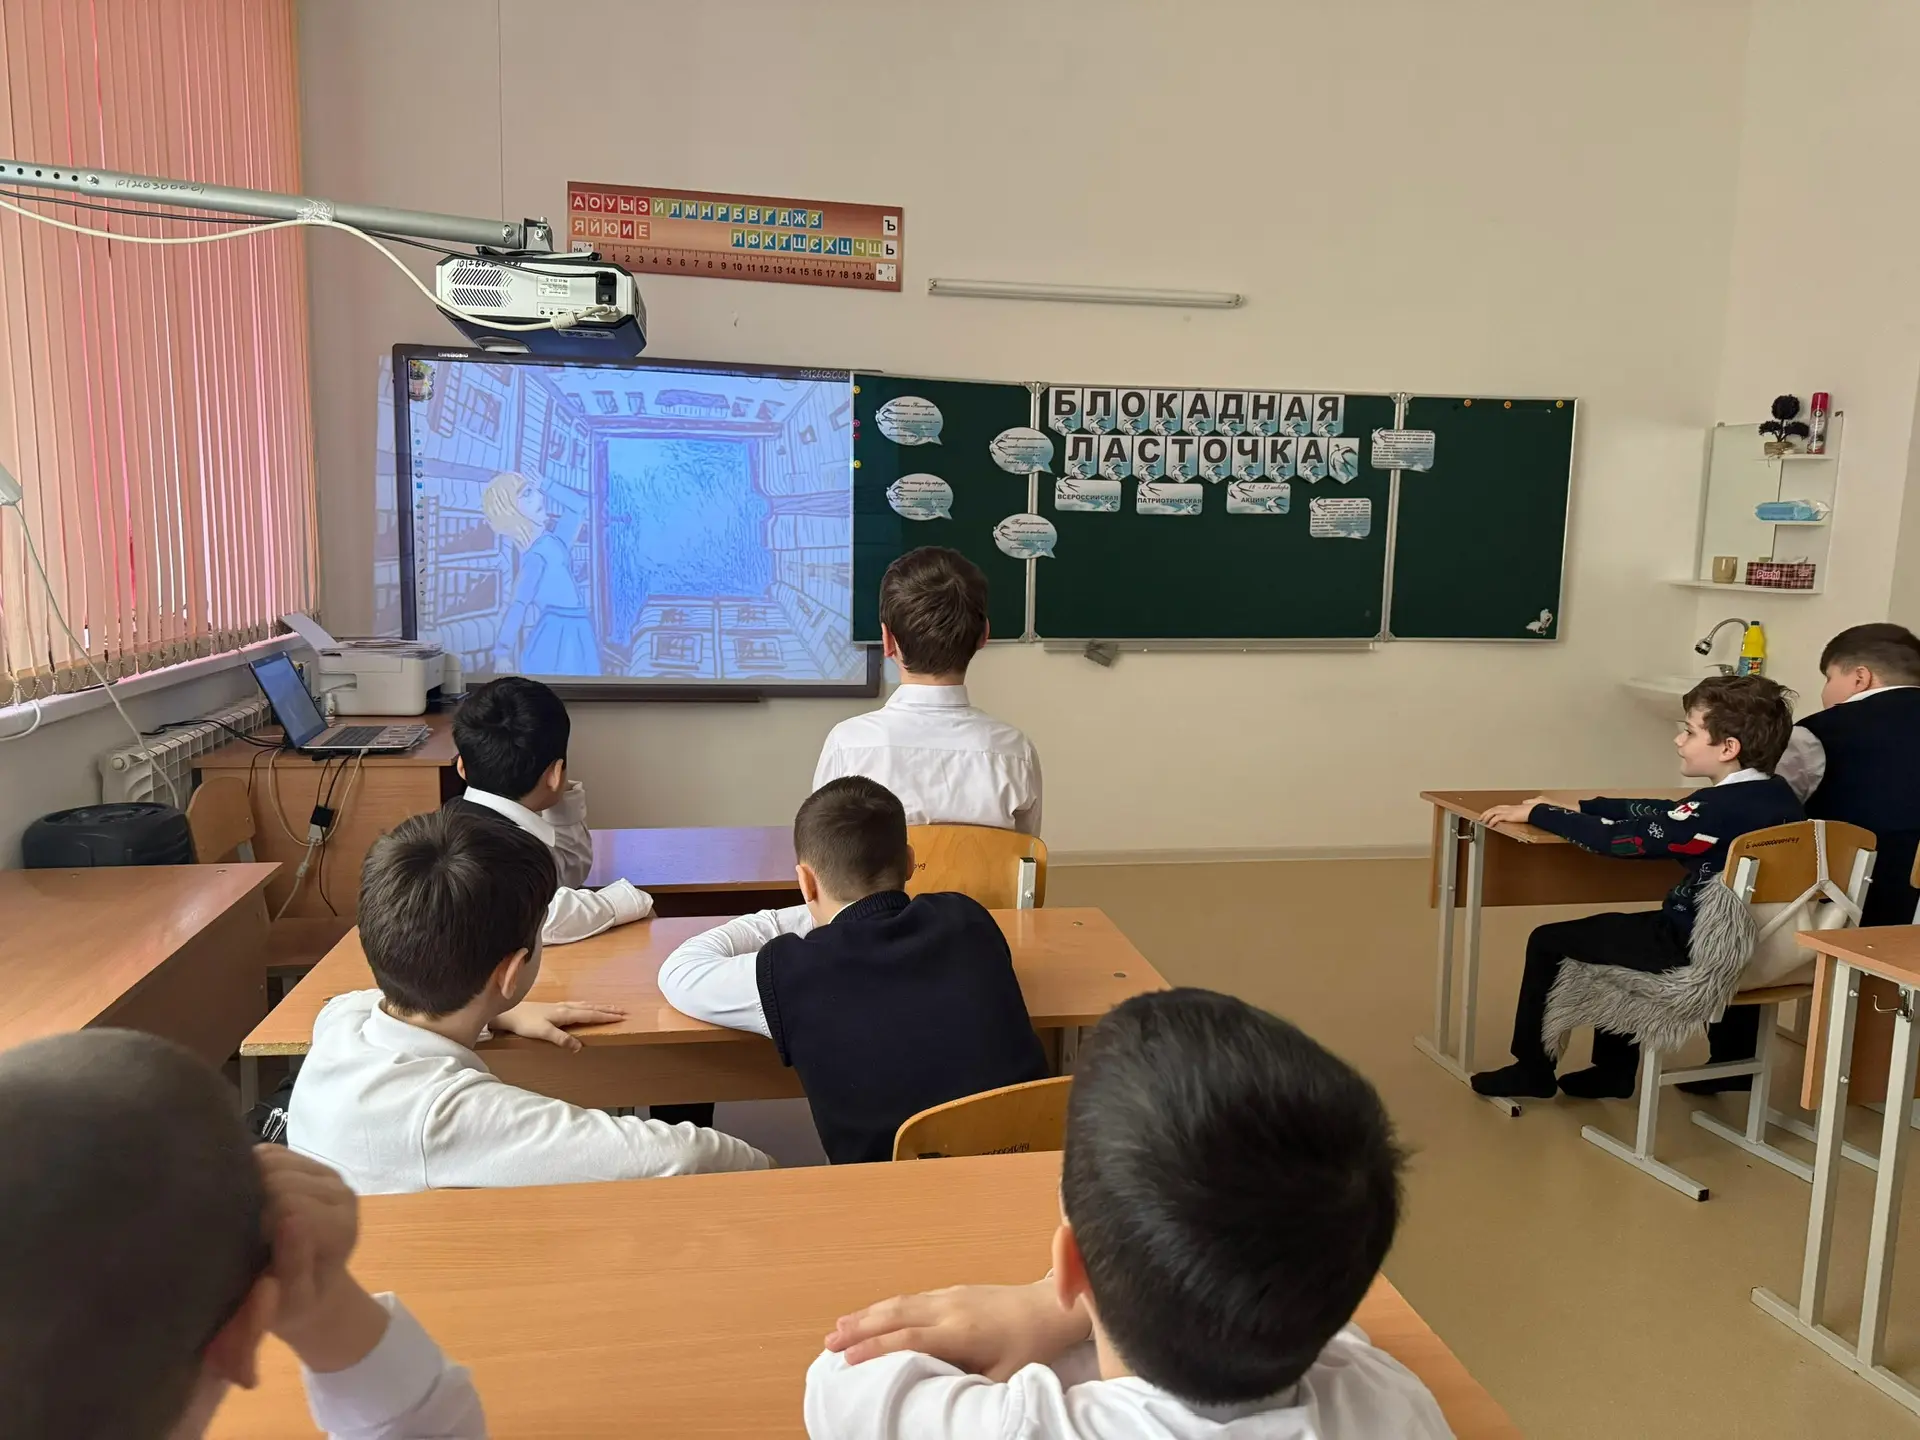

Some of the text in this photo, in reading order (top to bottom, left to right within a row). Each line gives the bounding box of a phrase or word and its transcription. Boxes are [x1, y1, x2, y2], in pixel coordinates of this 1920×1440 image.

[884, 220, 896, 231] Ъ
[886, 244, 895, 255] Ь
[612, 254, 616, 262] 1
[625, 254, 630, 262] 2
[639, 256, 644, 264] 3
[652, 257, 658, 265] 4
[694, 260, 699, 268] 7
[707, 260, 713, 268] 8
[721, 262, 727, 270] 9
[732, 263, 742, 271] 10
[747, 264, 756, 272] 11
[760, 265, 769, 273] 12
[773, 266, 783, 274] 13
[786, 267, 796, 275] 14
[800, 268, 809, 276] 15
[826, 270, 836, 278] 17
[1054, 390, 1339, 424] БЛОКАДНАЯ
[1068, 437, 1323, 464] ЛАСТОЧКА
